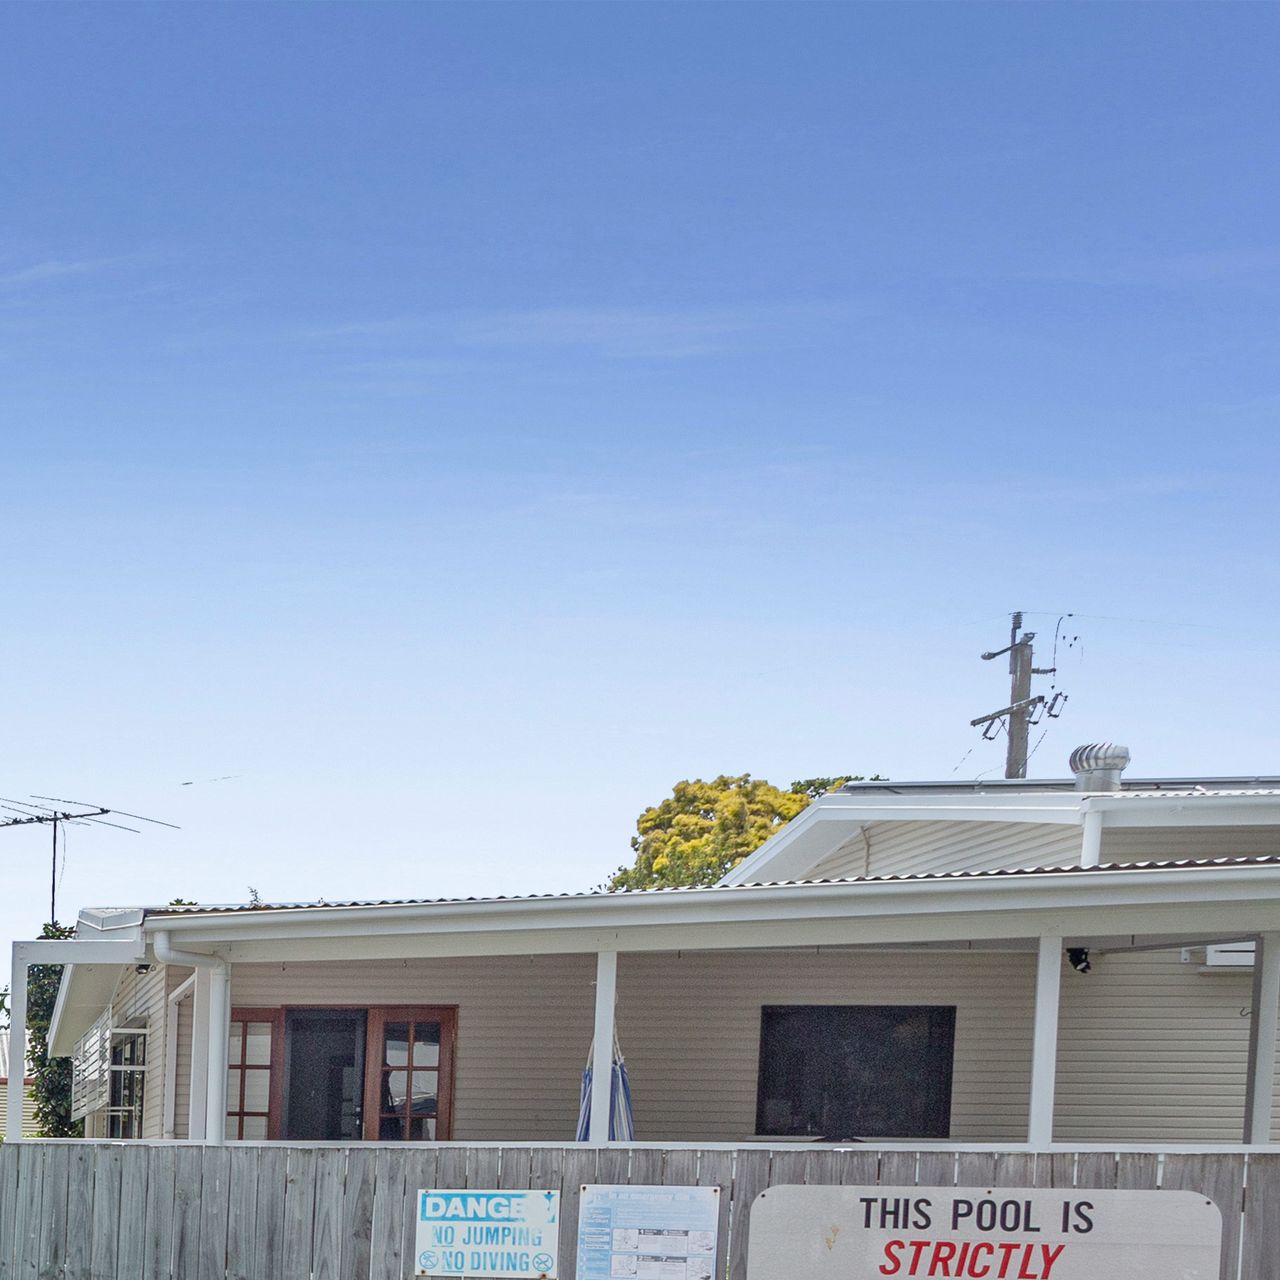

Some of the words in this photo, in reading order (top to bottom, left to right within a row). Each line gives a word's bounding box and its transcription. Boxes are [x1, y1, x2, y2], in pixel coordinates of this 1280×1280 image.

[425, 1196, 552, 1219] DANGE
[860, 1197, 933, 1231] THIS
[951, 1199, 1041, 1233] POOL
[1061, 1201, 1095, 1234] IS
[432, 1225, 456, 1246] NO
[462, 1226, 542, 1246] JUMPING
[441, 1250, 465, 1273] NO
[470, 1251, 530, 1272] DIVING
[878, 1240, 1066, 1280] STRICTLY
